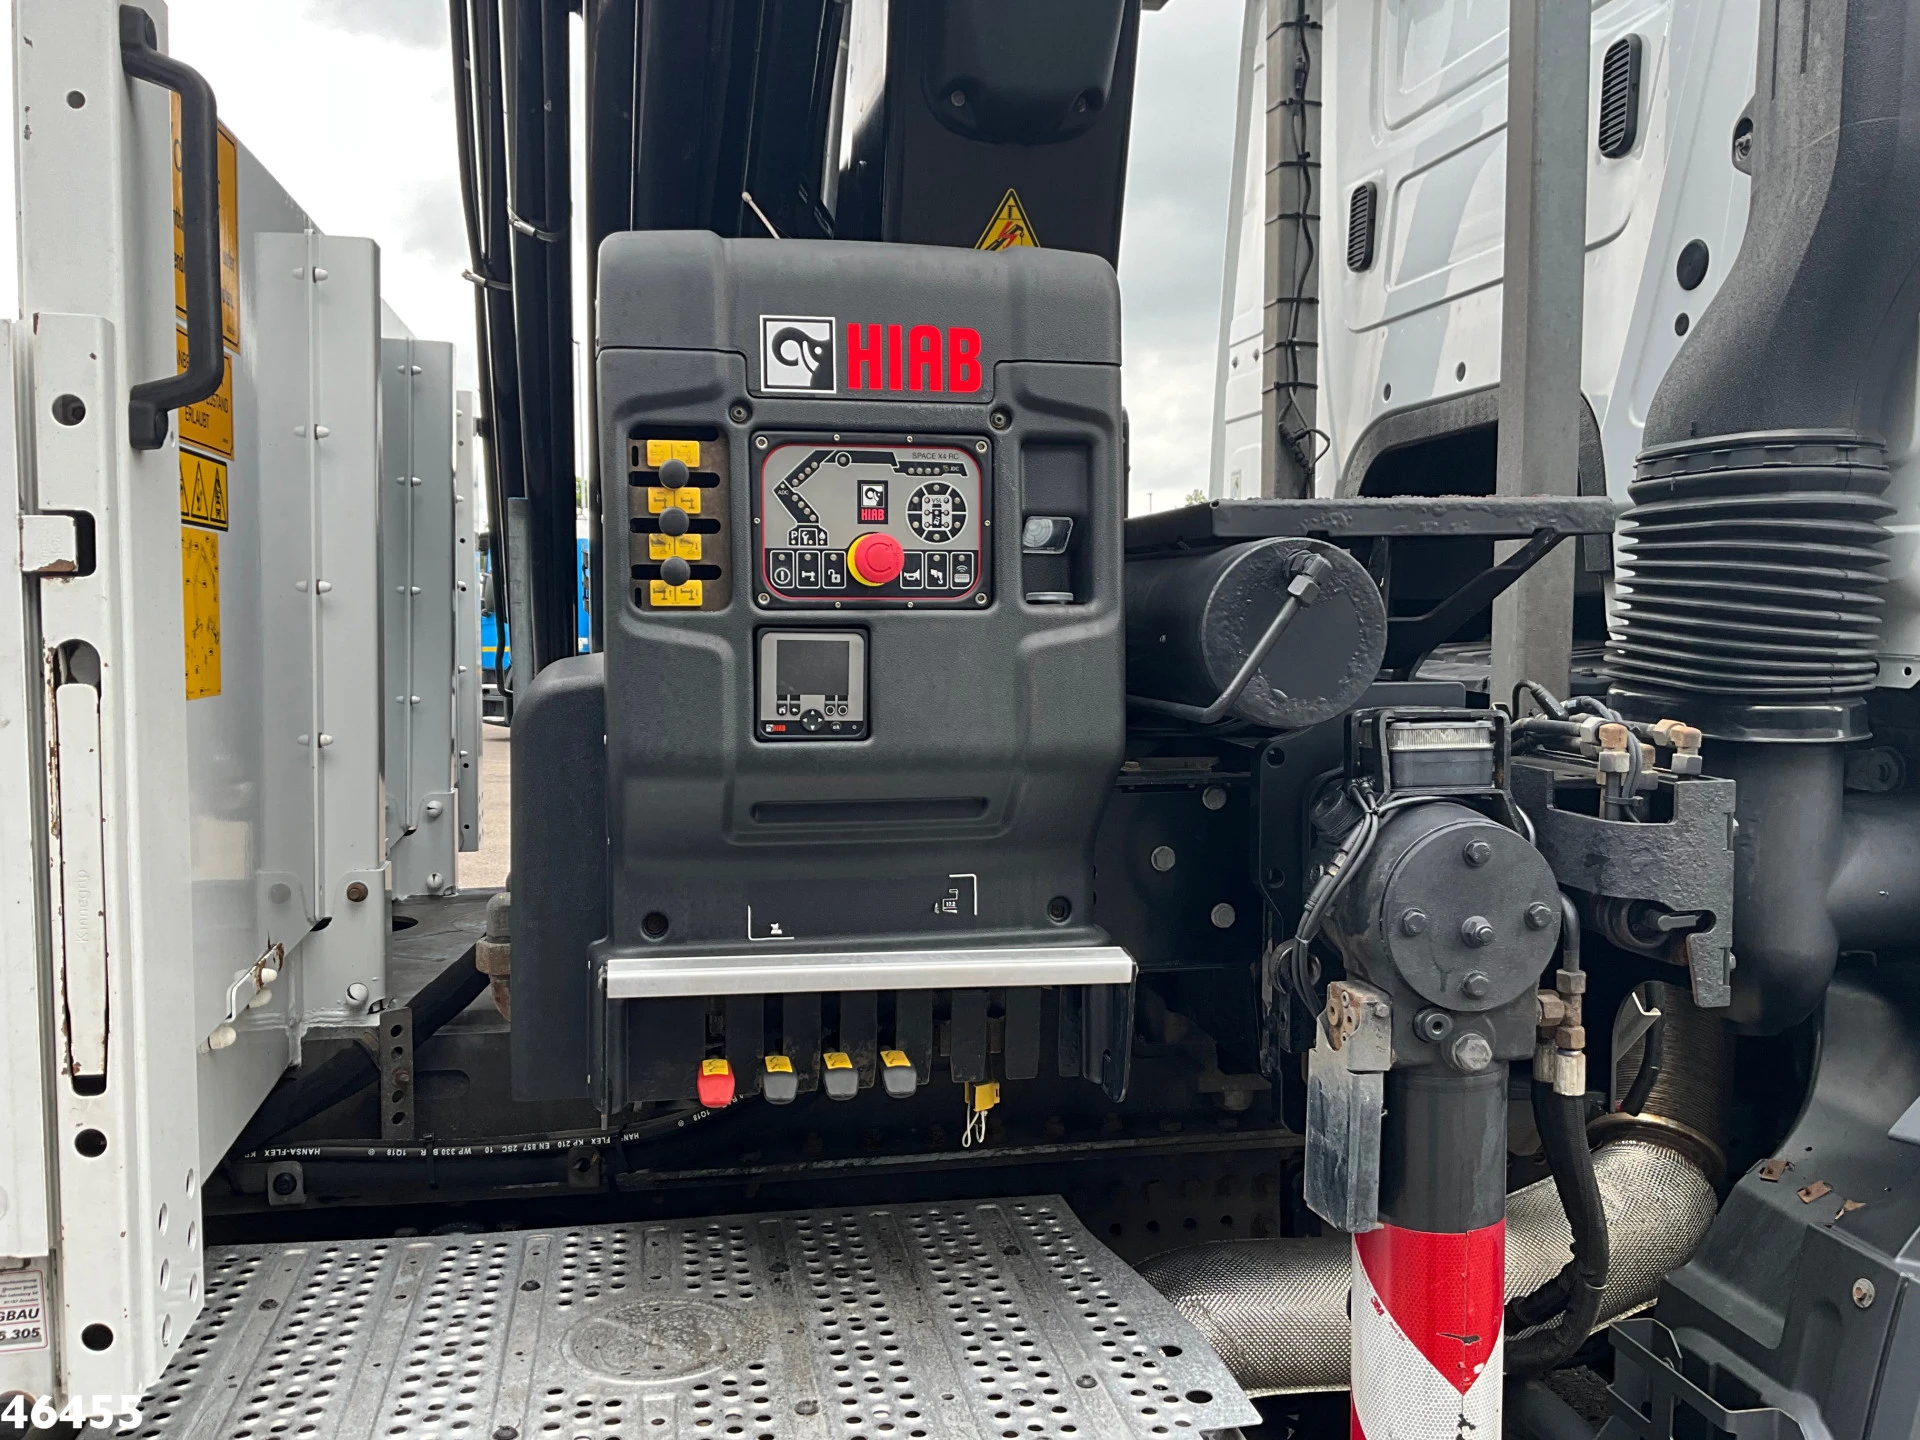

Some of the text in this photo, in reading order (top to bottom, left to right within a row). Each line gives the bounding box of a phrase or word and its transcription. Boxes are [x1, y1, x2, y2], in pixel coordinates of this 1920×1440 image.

[847, 322, 983, 393] HIAB
[185, 405, 210, 430] ERLAUBT
[911, 452, 959, 460] SPACE X4 RC
[861, 508, 884, 521] HIAB
[791, 531, 797, 539] P
[74, 869, 91, 943] Kinnegrip
[538, 1142, 550, 1150] EN
[557, 1140, 571, 1148] 210
[572, 1138, 584, 1146] KP
[458, 1147, 472, 1155] WP
[484, 1146, 494, 1154] 10
[501, 1145, 518, 1153] 2SC
[522, 1143, 537, 1151] 857
[264, 1147, 321, 1157] HANSA-FLEX
[441, 1148, 456, 1156] 330
[11, 1327, 41, 1340] 305
